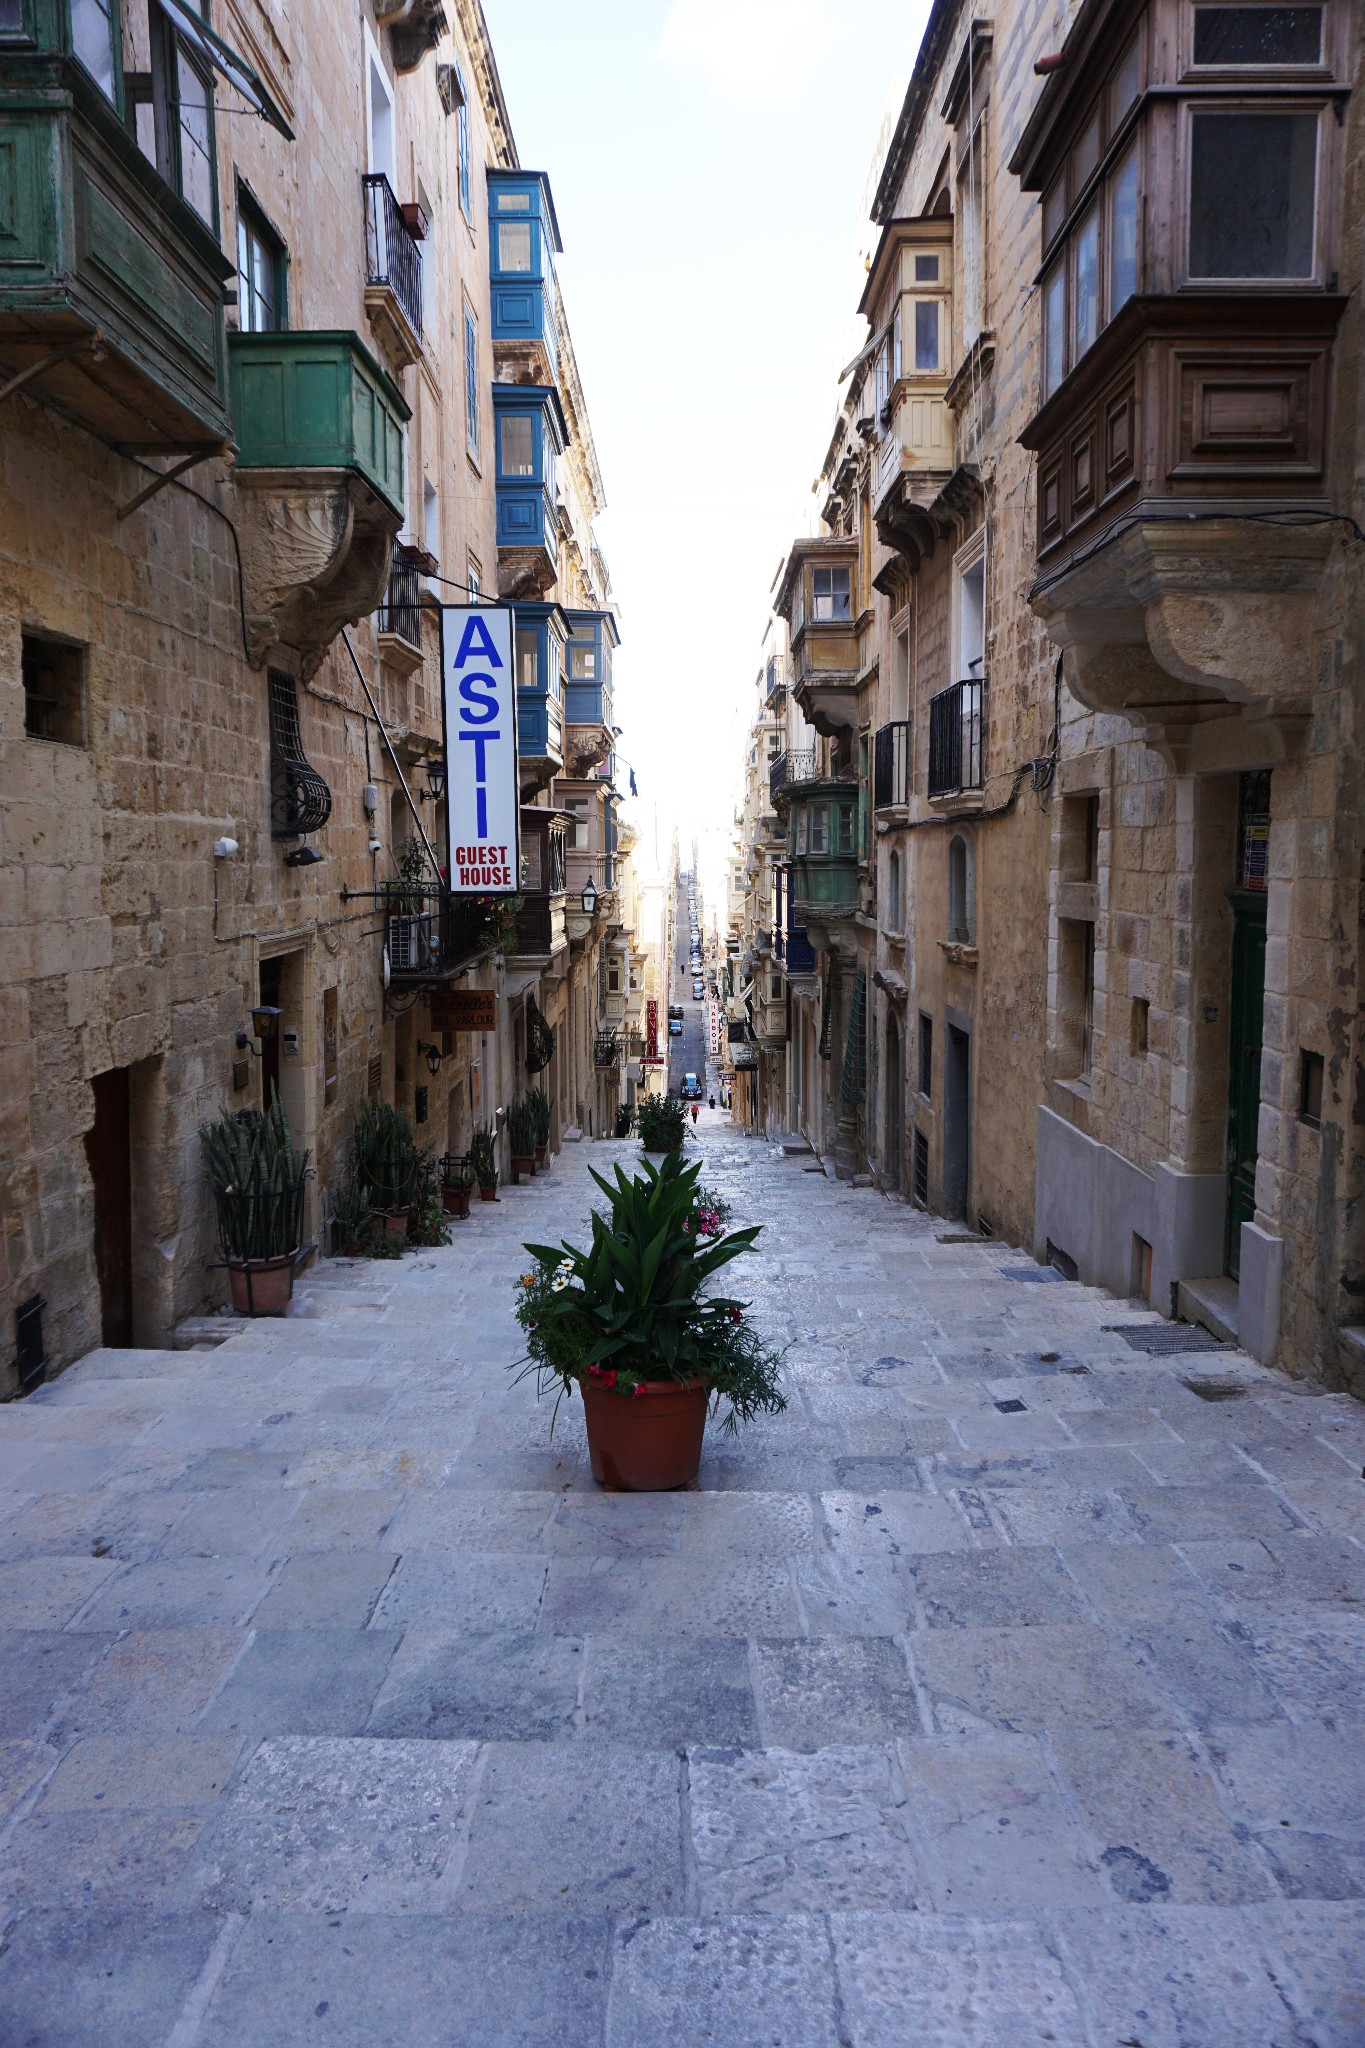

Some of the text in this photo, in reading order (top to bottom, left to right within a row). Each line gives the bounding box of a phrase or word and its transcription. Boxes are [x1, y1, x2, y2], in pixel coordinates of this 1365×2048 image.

[453, 615, 504, 839] ASTI
[456, 846, 507, 865] GUEST
[460, 866, 511, 886] HOUSE
[456, 1014, 494, 1025] PARLOUR
